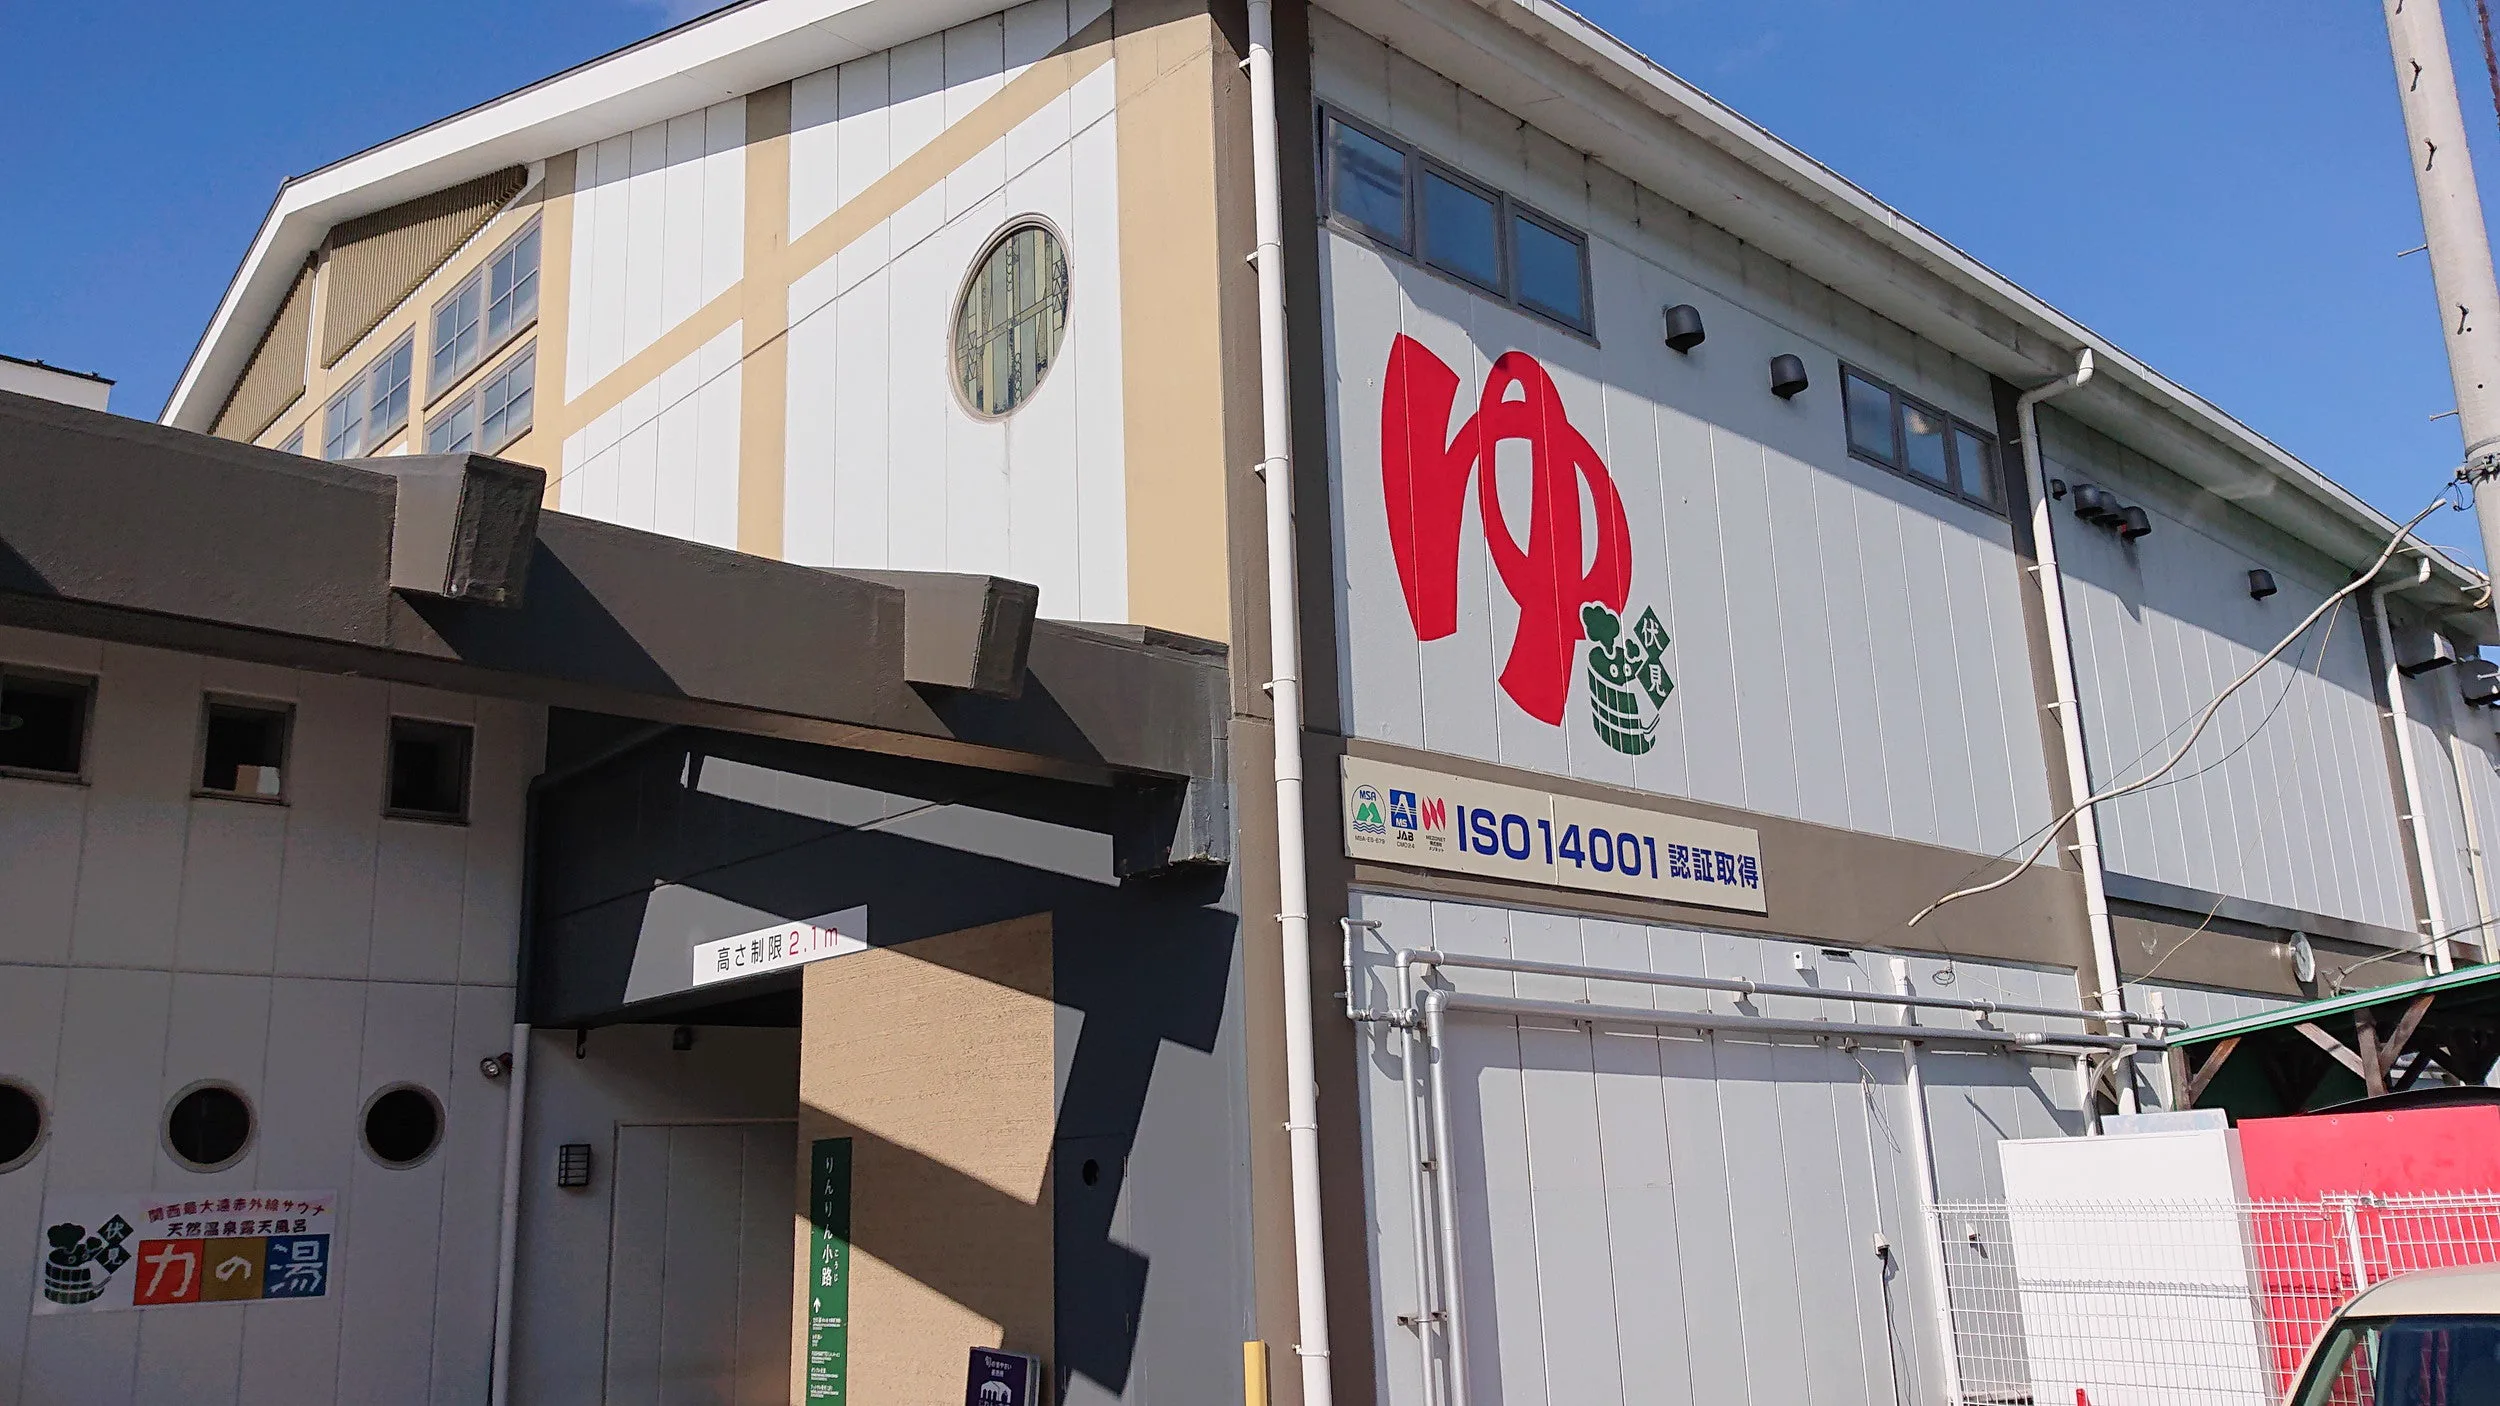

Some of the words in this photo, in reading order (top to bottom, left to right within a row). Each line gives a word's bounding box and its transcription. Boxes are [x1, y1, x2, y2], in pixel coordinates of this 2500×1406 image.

[1381, 332, 1633, 728] ゆ
[1641, 616, 1667, 697] 伏見
[1359, 790, 1376, 801] MSA
[1397, 830, 1414, 841] JAB
[1457, 805, 1659, 880] ISO14001
[1668, 843, 1759, 890] 認証取得
[147, 1197, 326, 1224] 関西最大遠赤外線サウナ
[166, 1218, 307, 1238] 天然温泉露天風呂
[821, 1157, 834, 1287] りんりん小路
[103, 1221, 126, 1266] 伏見
[144, 1239, 324, 1298] 力の湯
